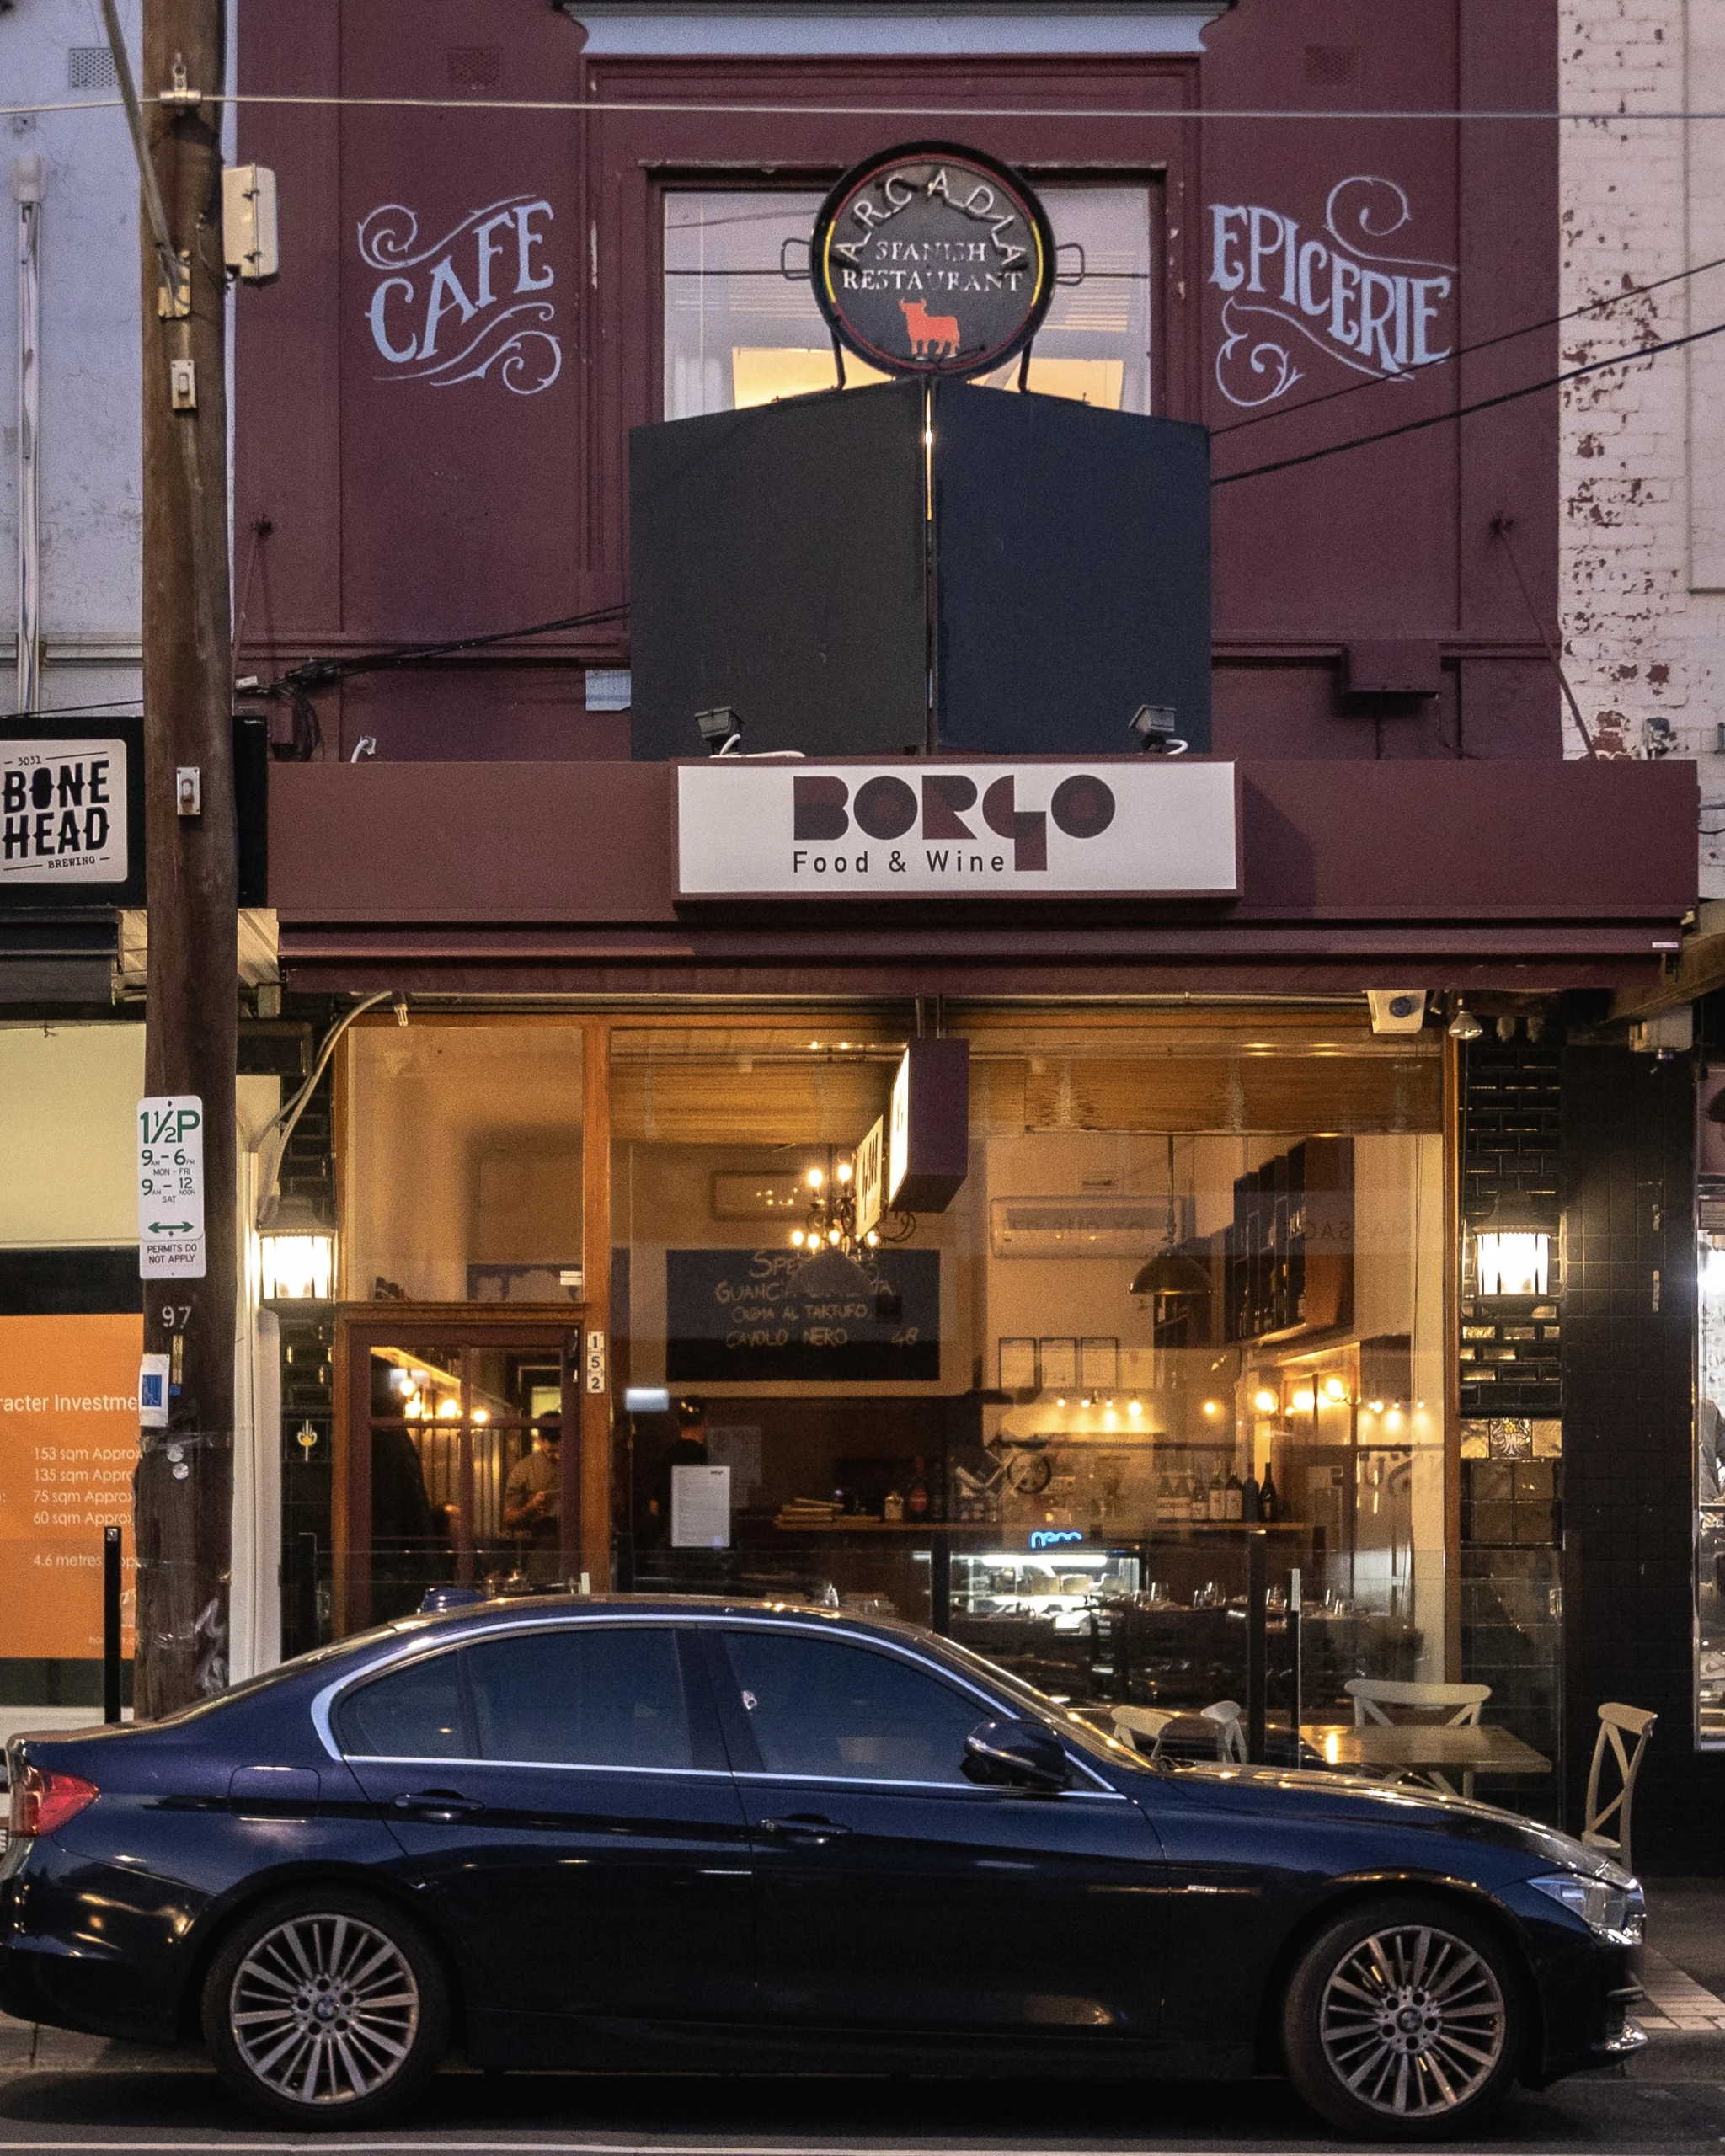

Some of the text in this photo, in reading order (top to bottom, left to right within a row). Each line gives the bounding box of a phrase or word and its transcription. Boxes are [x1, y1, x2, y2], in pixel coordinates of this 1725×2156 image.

[835, 168, 1027, 265] ARCADIA
[365, 200, 554, 363] CAFE
[842, 269, 1023, 291] RESTAURANT
[1207, 203, 1451, 374] EPICERIE
[18, 755, 41, 766] 3031
[1, 760, 110, 814] BONE
[793, 775, 1115, 871] BORGO
[2, 806, 110, 859] HEAD
[47, 856, 95, 869] BREWING
[793, 850, 1004, 873] Food & Wine
[147, 1244, 197, 1253] PERMITS DO
[168, 1254, 195, 1263] APPLY
[162, 1306, 191, 1328] 97
[0, 1394, 137, 1412] acter Investme
[35, 1448, 56, 1460] 153
[60, 1450, 88, 1462] sqm
[35, 1469, 134, 1483] 135 sqm Appro
[34, 1490, 49, 1502] 75
[52, 1493, 81, 1505] sqm
[33, 1511, 49, 1524] 60
[52, 1514, 81, 1526] sqm
[34, 1554, 52, 1566] 4.6
